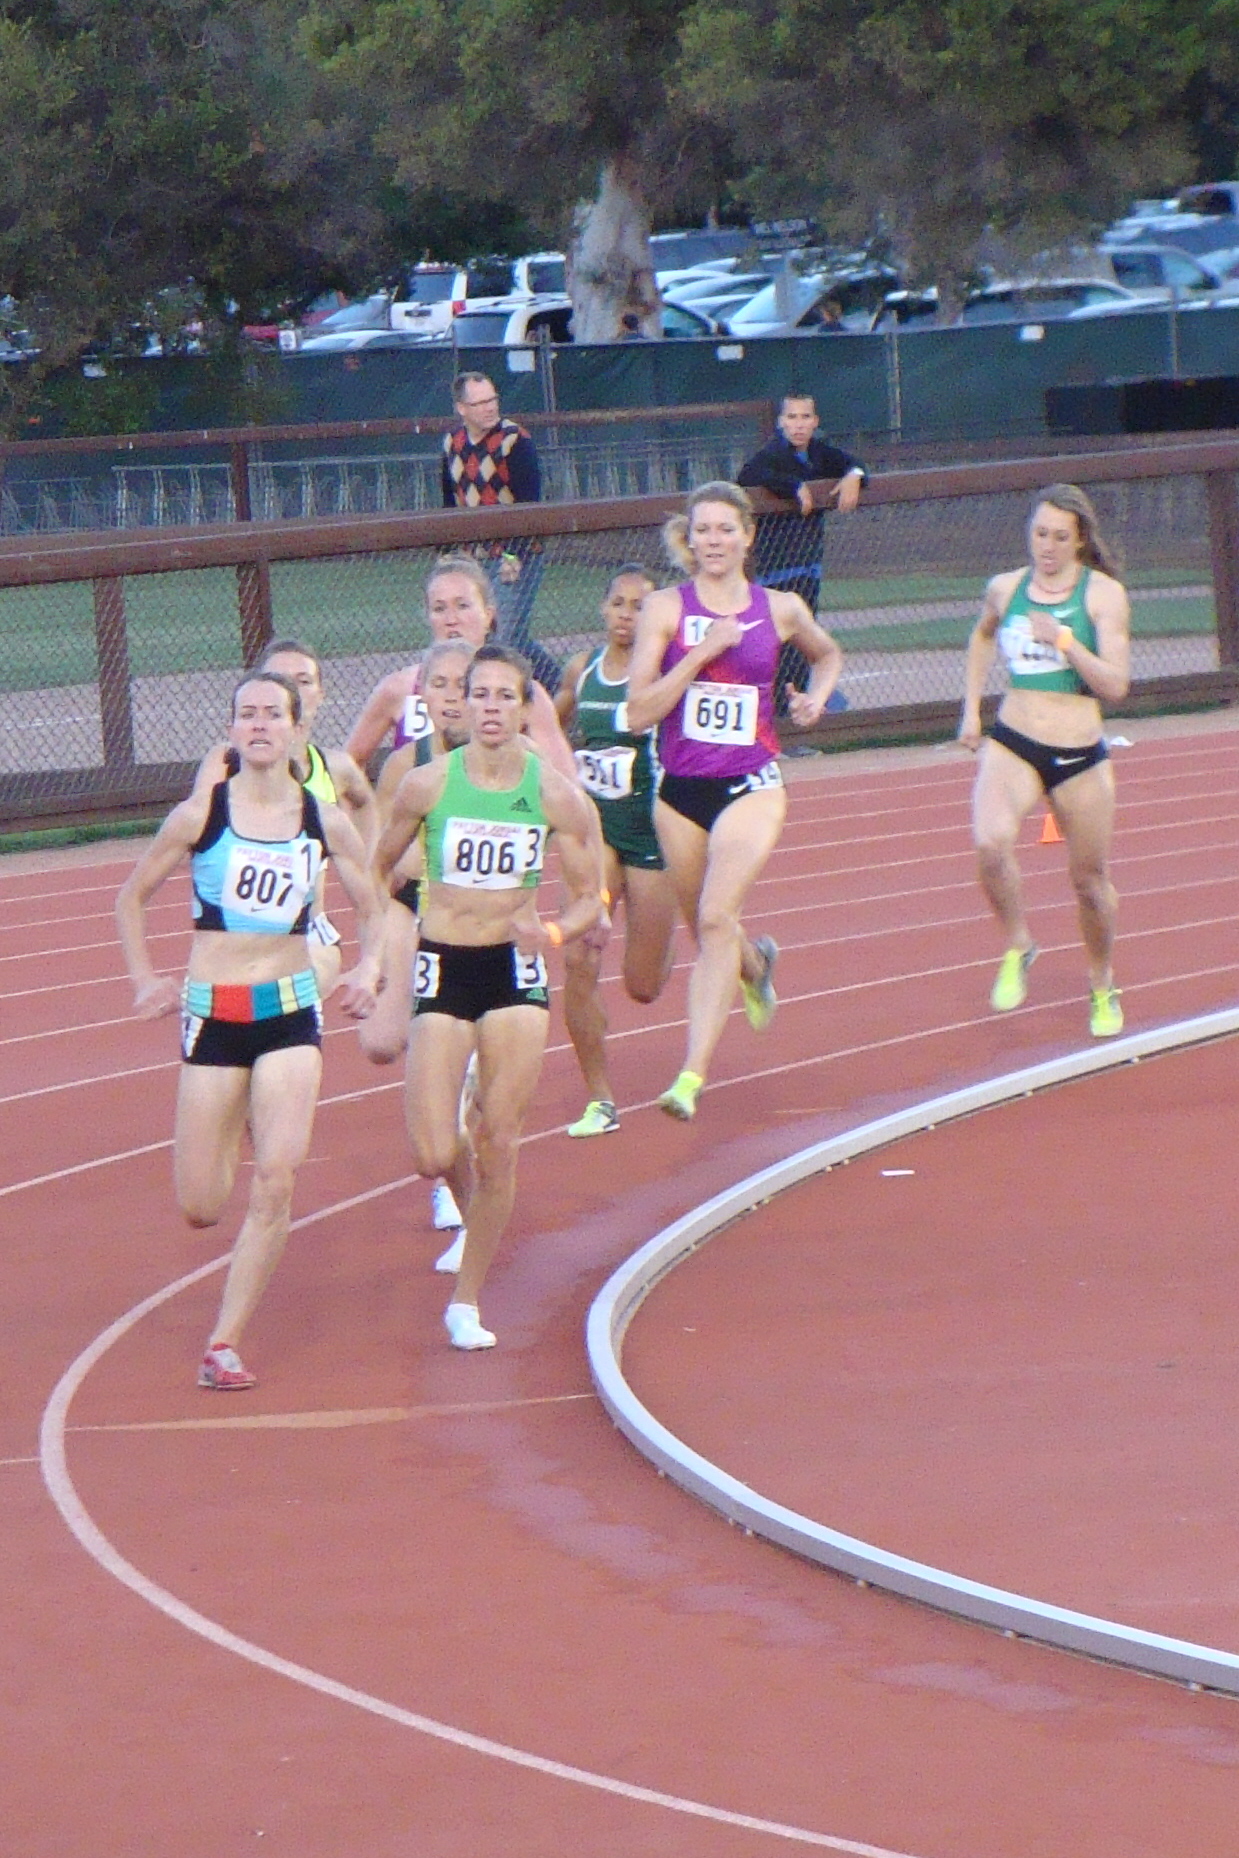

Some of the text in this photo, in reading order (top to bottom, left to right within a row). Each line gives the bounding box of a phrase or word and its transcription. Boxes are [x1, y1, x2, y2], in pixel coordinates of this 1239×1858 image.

[412, 698, 429, 733] 5
[696, 697, 744, 731] 691
[300, 843, 312, 883] 1
[456, 838, 516, 876] 806
[524, 828, 541, 868] 3
[236, 864, 294, 907] 807
[415, 954, 431, 994] 3
